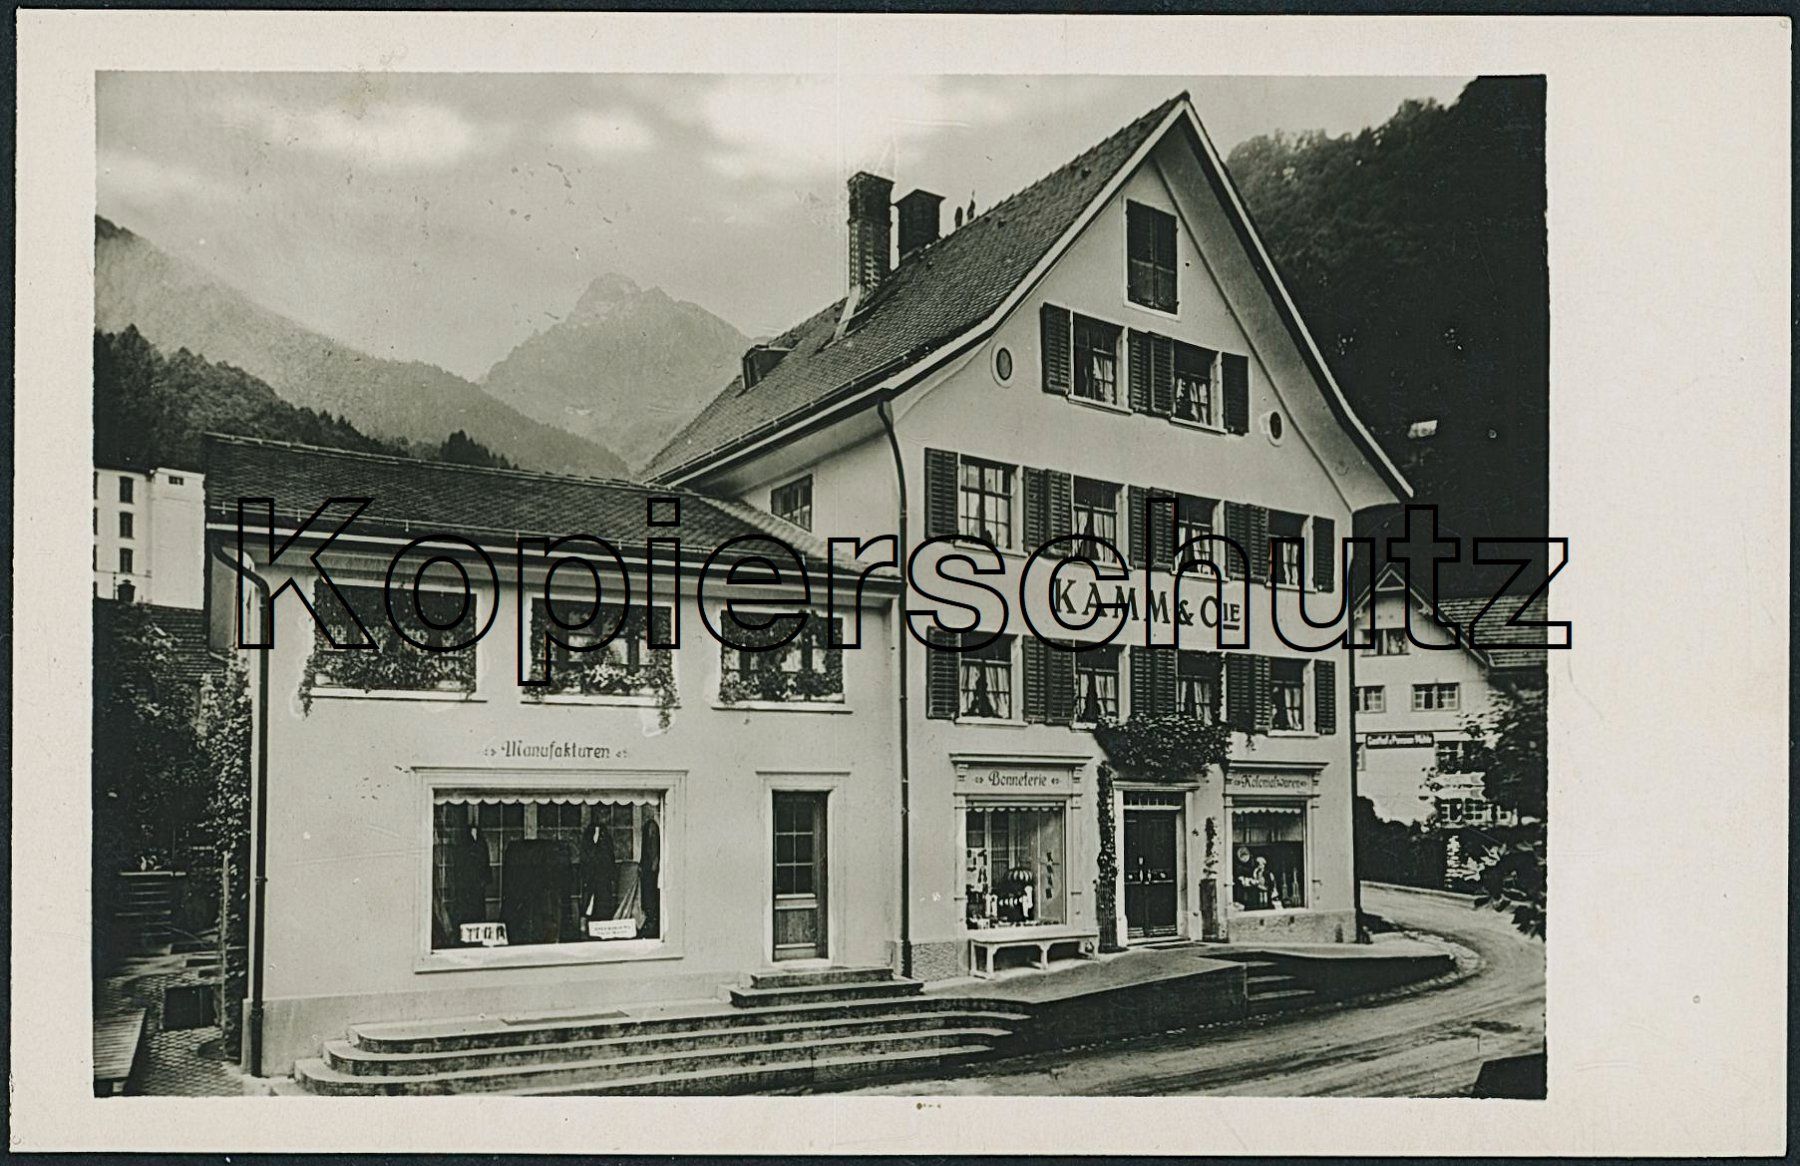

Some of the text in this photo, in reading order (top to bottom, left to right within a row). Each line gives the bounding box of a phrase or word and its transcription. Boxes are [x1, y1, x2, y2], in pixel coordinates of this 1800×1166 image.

[1054, 578, 1171, 624] KAMM
[1178, 600, 1194, 626] &
[501, 739, 611, 760] Manufakturen
[988, 770, 1047, 787] Bonneterie
